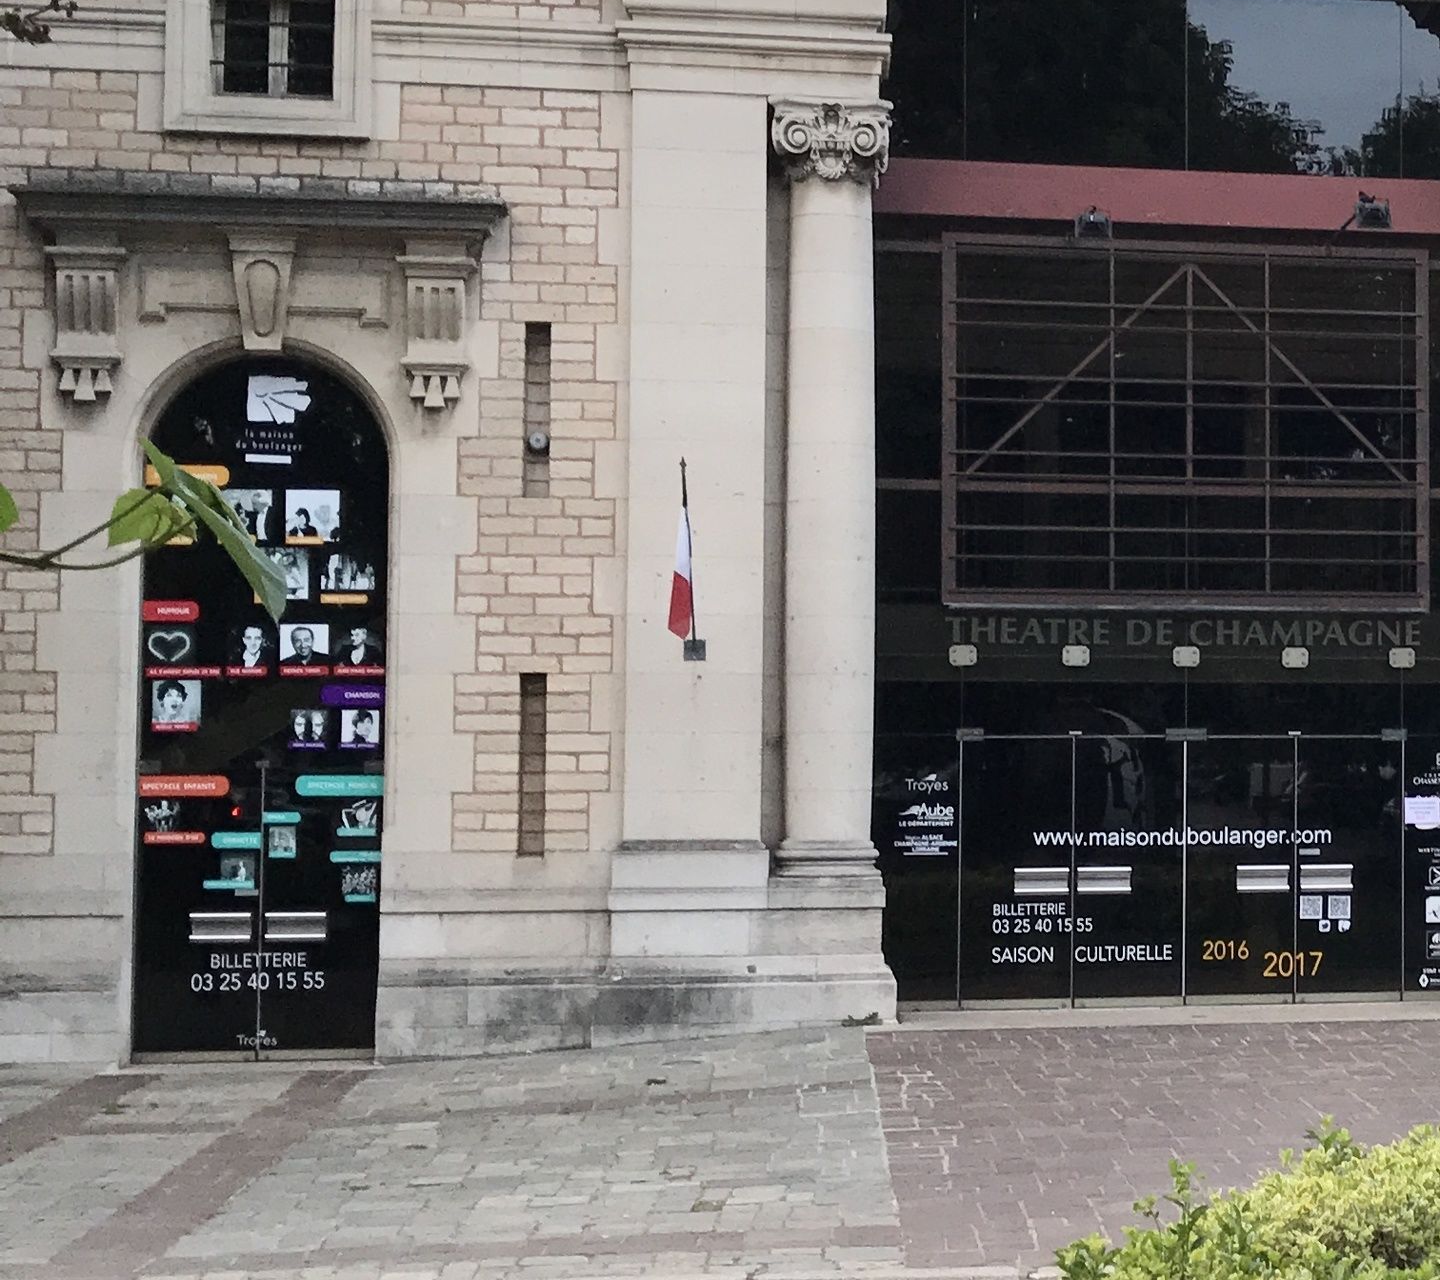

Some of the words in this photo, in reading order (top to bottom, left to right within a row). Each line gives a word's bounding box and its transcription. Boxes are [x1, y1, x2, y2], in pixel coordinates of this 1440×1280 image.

[260, 430, 294, 439] maison
[252, 440, 302, 452] boulanger
[946, 617, 1110, 645] THEATRE
[1126, 619, 1173, 645] DE
[1189, 618, 1422, 647] CHAMPAGNE
[905, 778, 949, 794] Troyes
[919, 803, 954, 817] Aube
[1033, 826, 1332, 849] www.maisonduboulanger.com
[993, 903, 1066, 917] BILLETTERIE
[993, 919, 1010, 934] 03
[1014, 919, 1031, 933] 25
[1035, 918, 1052, 933] 40
[1056, 918, 1072, 933] 15
[1076, 917, 1093, 932] 55
[210, 952, 307, 969] BILLETTERIE
[991, 946, 1054, 964] SAISON
[1075, 944, 1173, 962] CULTURELLE
[1202, 940, 1249, 961] 2016
[1263, 951, 1323, 978] 2017
[191, 973, 213, 991] 03
[219, 972, 241, 991] 25
[247, 972, 269, 990] 40
[276, 972, 297, 989] 15
[302, 971, 325, 989] 55
